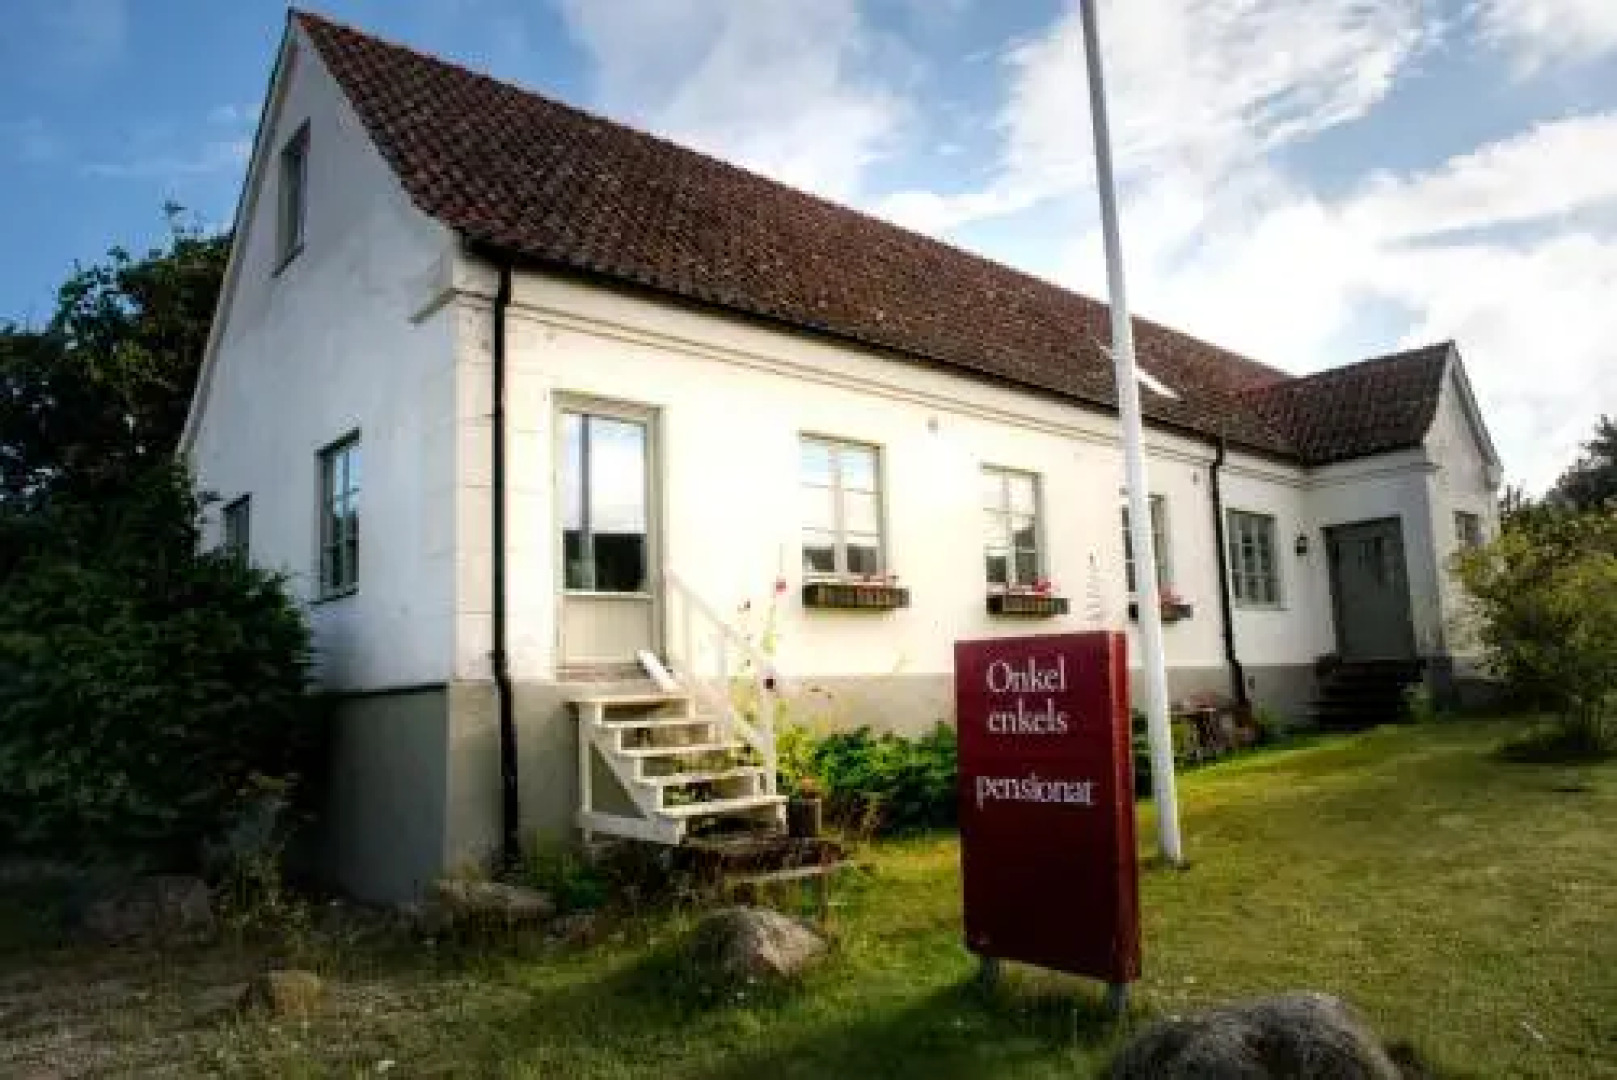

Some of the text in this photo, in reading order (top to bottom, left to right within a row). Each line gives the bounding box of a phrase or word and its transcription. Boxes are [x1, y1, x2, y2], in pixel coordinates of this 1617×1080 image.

[986, 656, 1066, 693] Onkel
[987, 698, 1069, 735] enkels
[976, 773, 1093, 810] pensionat
